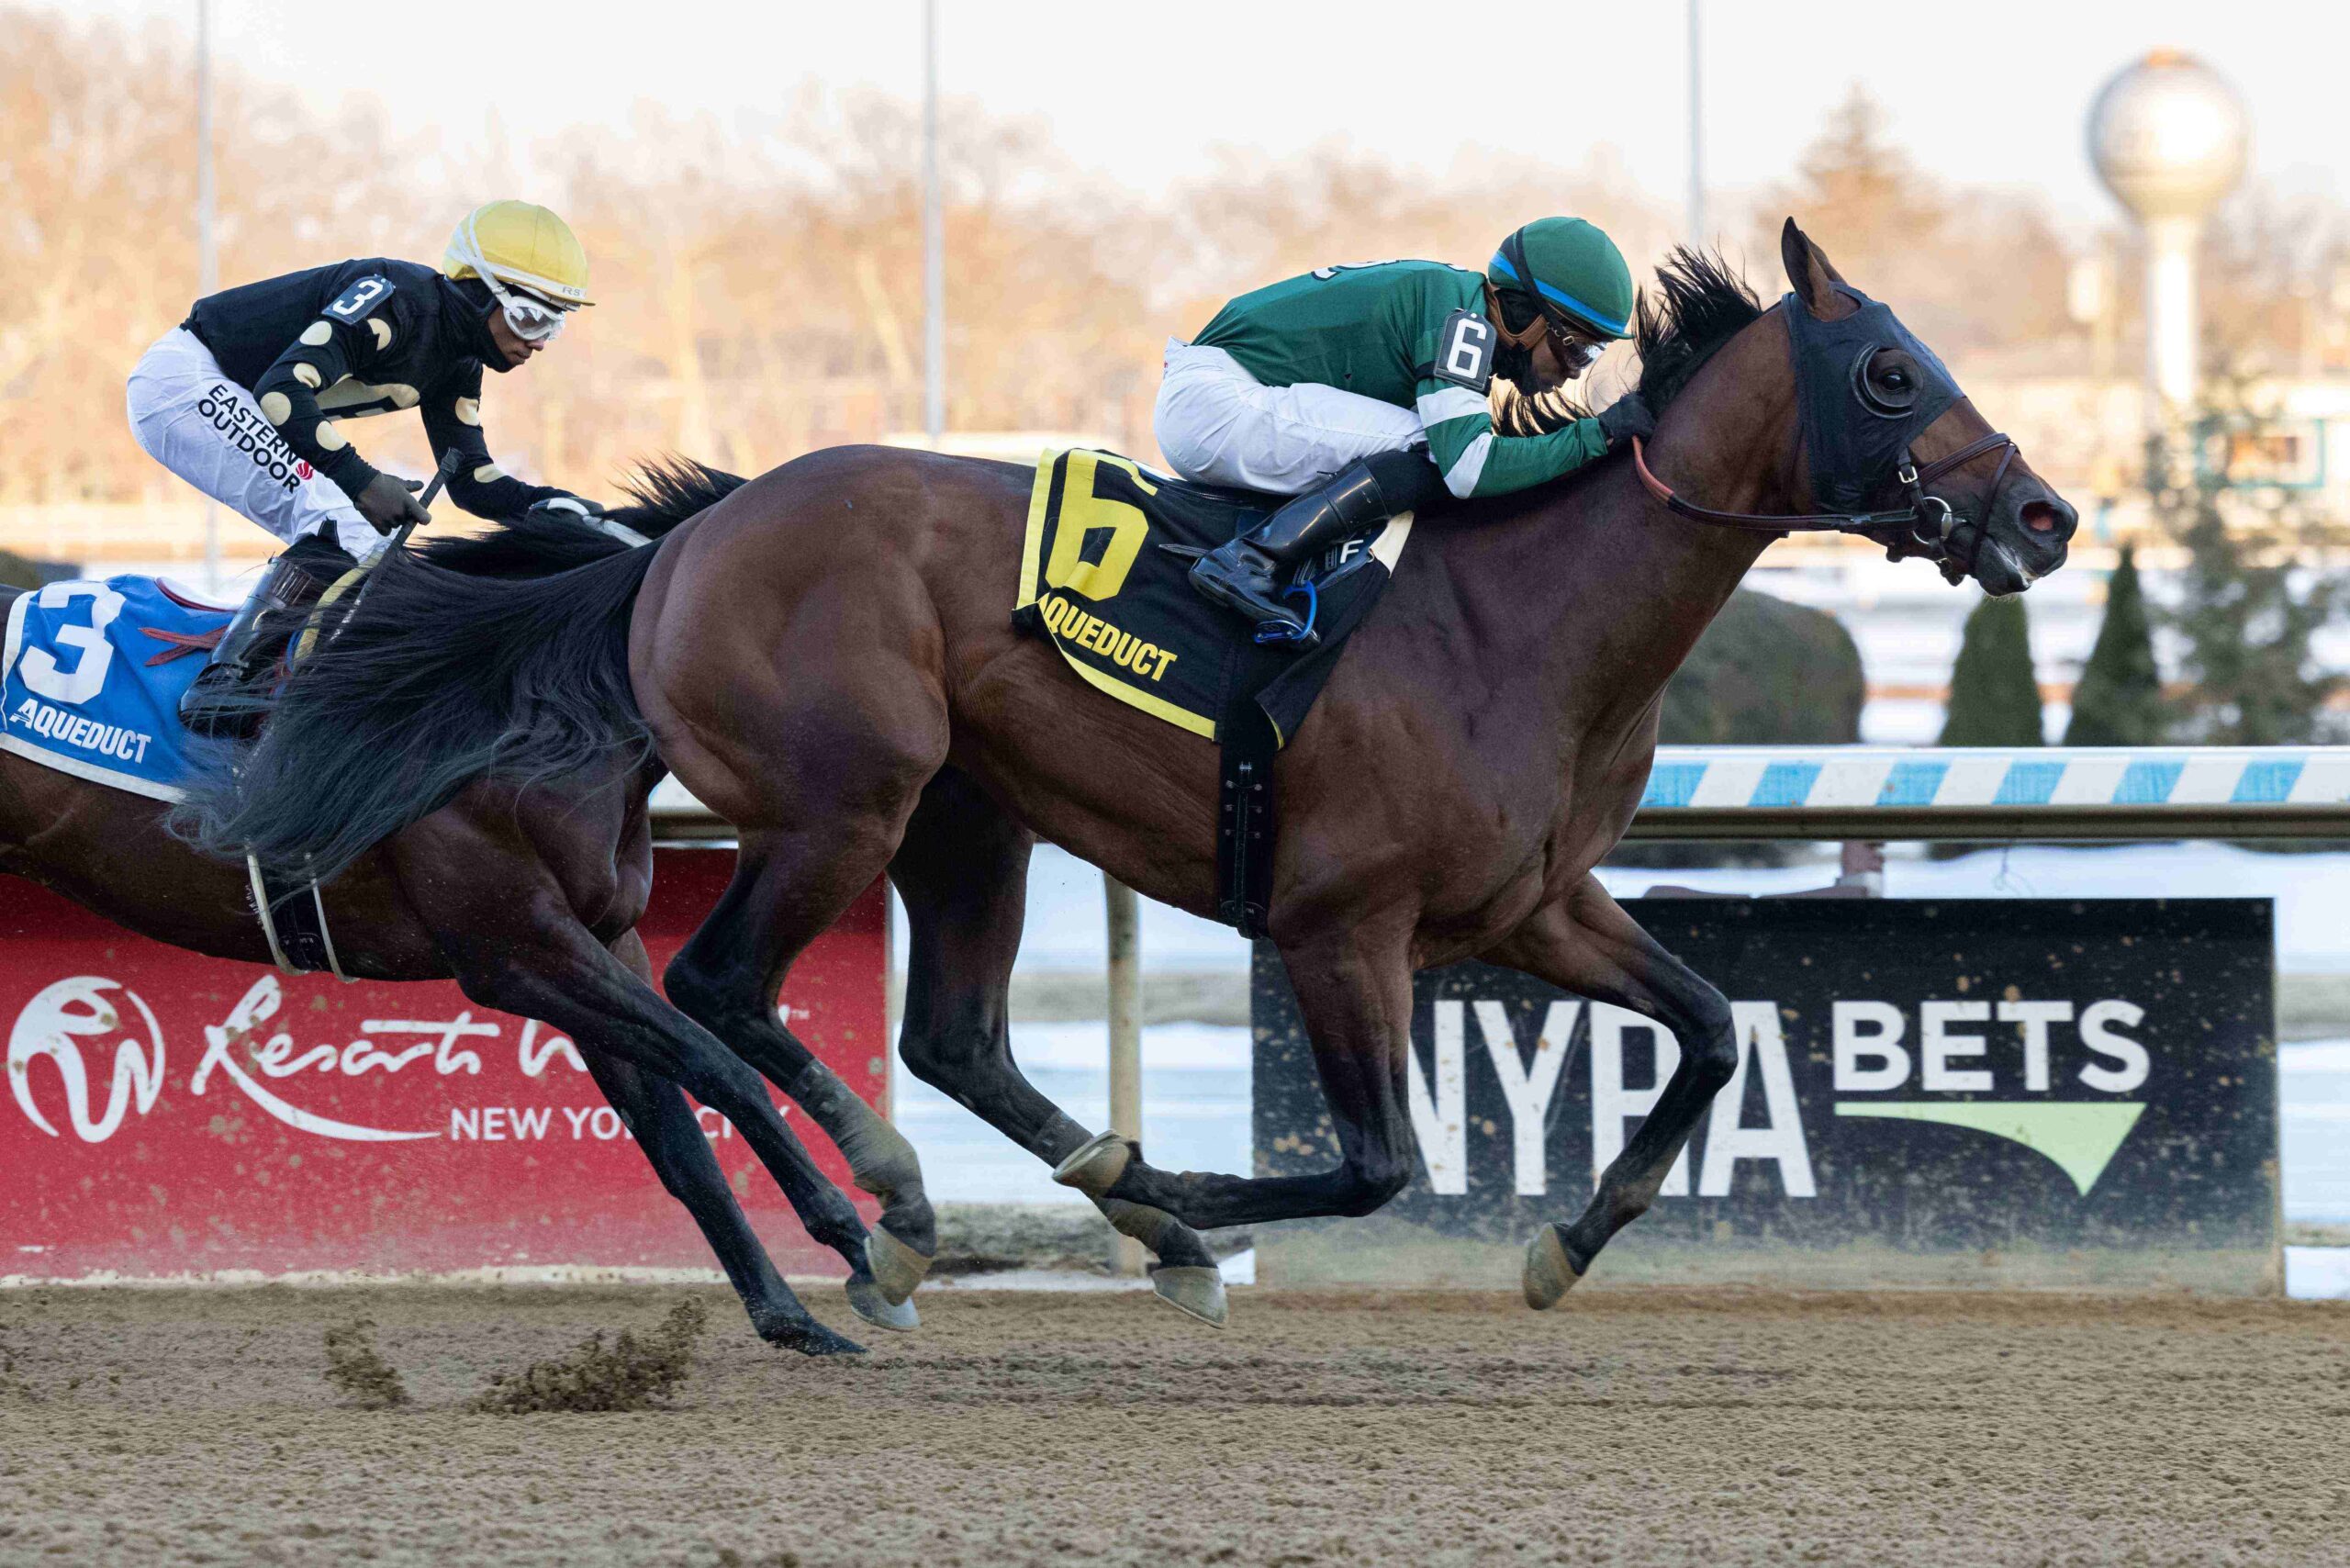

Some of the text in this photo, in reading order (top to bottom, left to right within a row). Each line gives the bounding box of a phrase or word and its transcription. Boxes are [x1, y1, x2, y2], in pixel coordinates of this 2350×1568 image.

[332, 280, 384, 316] 3
[1447, 318, 1488, 379] 6
[197, 398, 301, 494] OUTDOOR
[207, 384, 299, 466] EASTERN
[1045, 448, 1158, 602] 6
[19, 580, 127, 705] 3
[8, 698, 152, 764] AQUEDUCT
[190, 974, 501, 1142] Resorts
[1832, 999, 2150, 1093] BETS
[451, 1106, 553, 1141] NEW
[562, 1105, 634, 1141] YO
